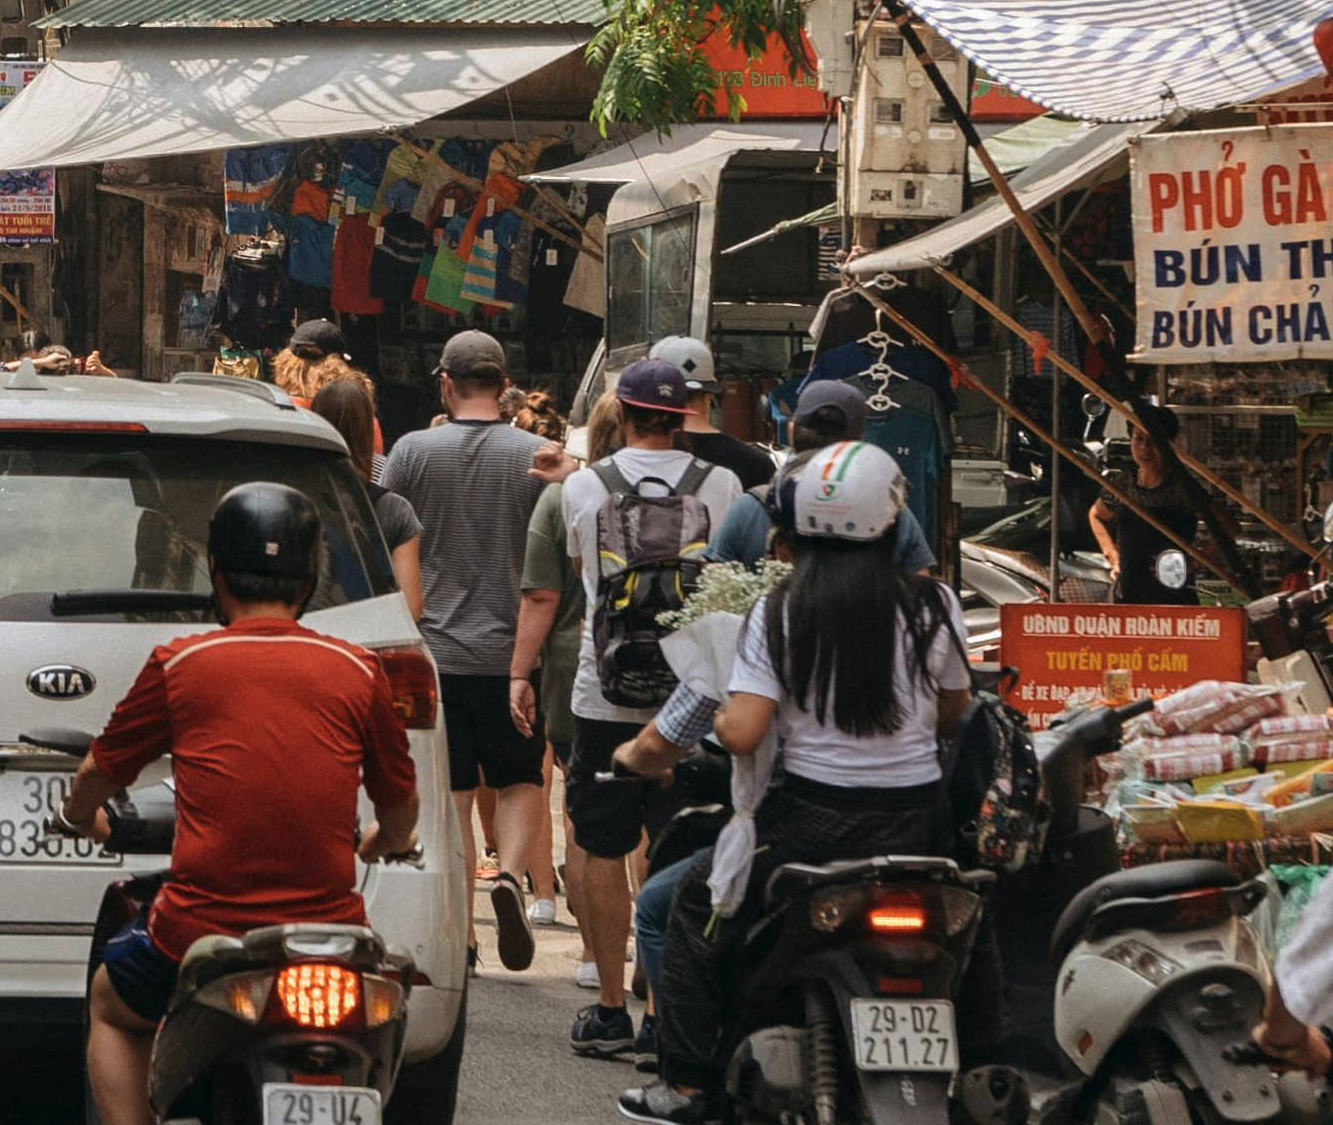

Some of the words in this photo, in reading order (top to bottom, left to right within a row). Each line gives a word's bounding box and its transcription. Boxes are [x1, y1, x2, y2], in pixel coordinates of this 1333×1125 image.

[1148, 140, 1246, 233] PHỞ
[1262, 149, 1327, 226] GÀ
[1154, 238, 1262, 288] BÚN
[1151, 301, 1233, 349] BÚN
[1248, 284, 1331, 345] CHẢ
[1023, 615, 1068, 634] UBND
[1074, 613, 1120, 638] QUẬN
[1125, 614, 1172, 636] HOÀN
[1177, 613, 1221, 637] KIẾM
[1046, 646, 1102, 671] TUYẾN
[1107, 648, 1142, 671] PHỐ
[1148, 649, 1188, 672] CẤM
[39, 672, 85, 694] KIA
[1036, 685, 1049, 700] XE
[23, 776, 75, 813] 30
[869, 1005, 940, 1034] 29-D2
[863, 1036, 949, 1065] 211.27
[283, 1093, 362, 1125] 29-U4
